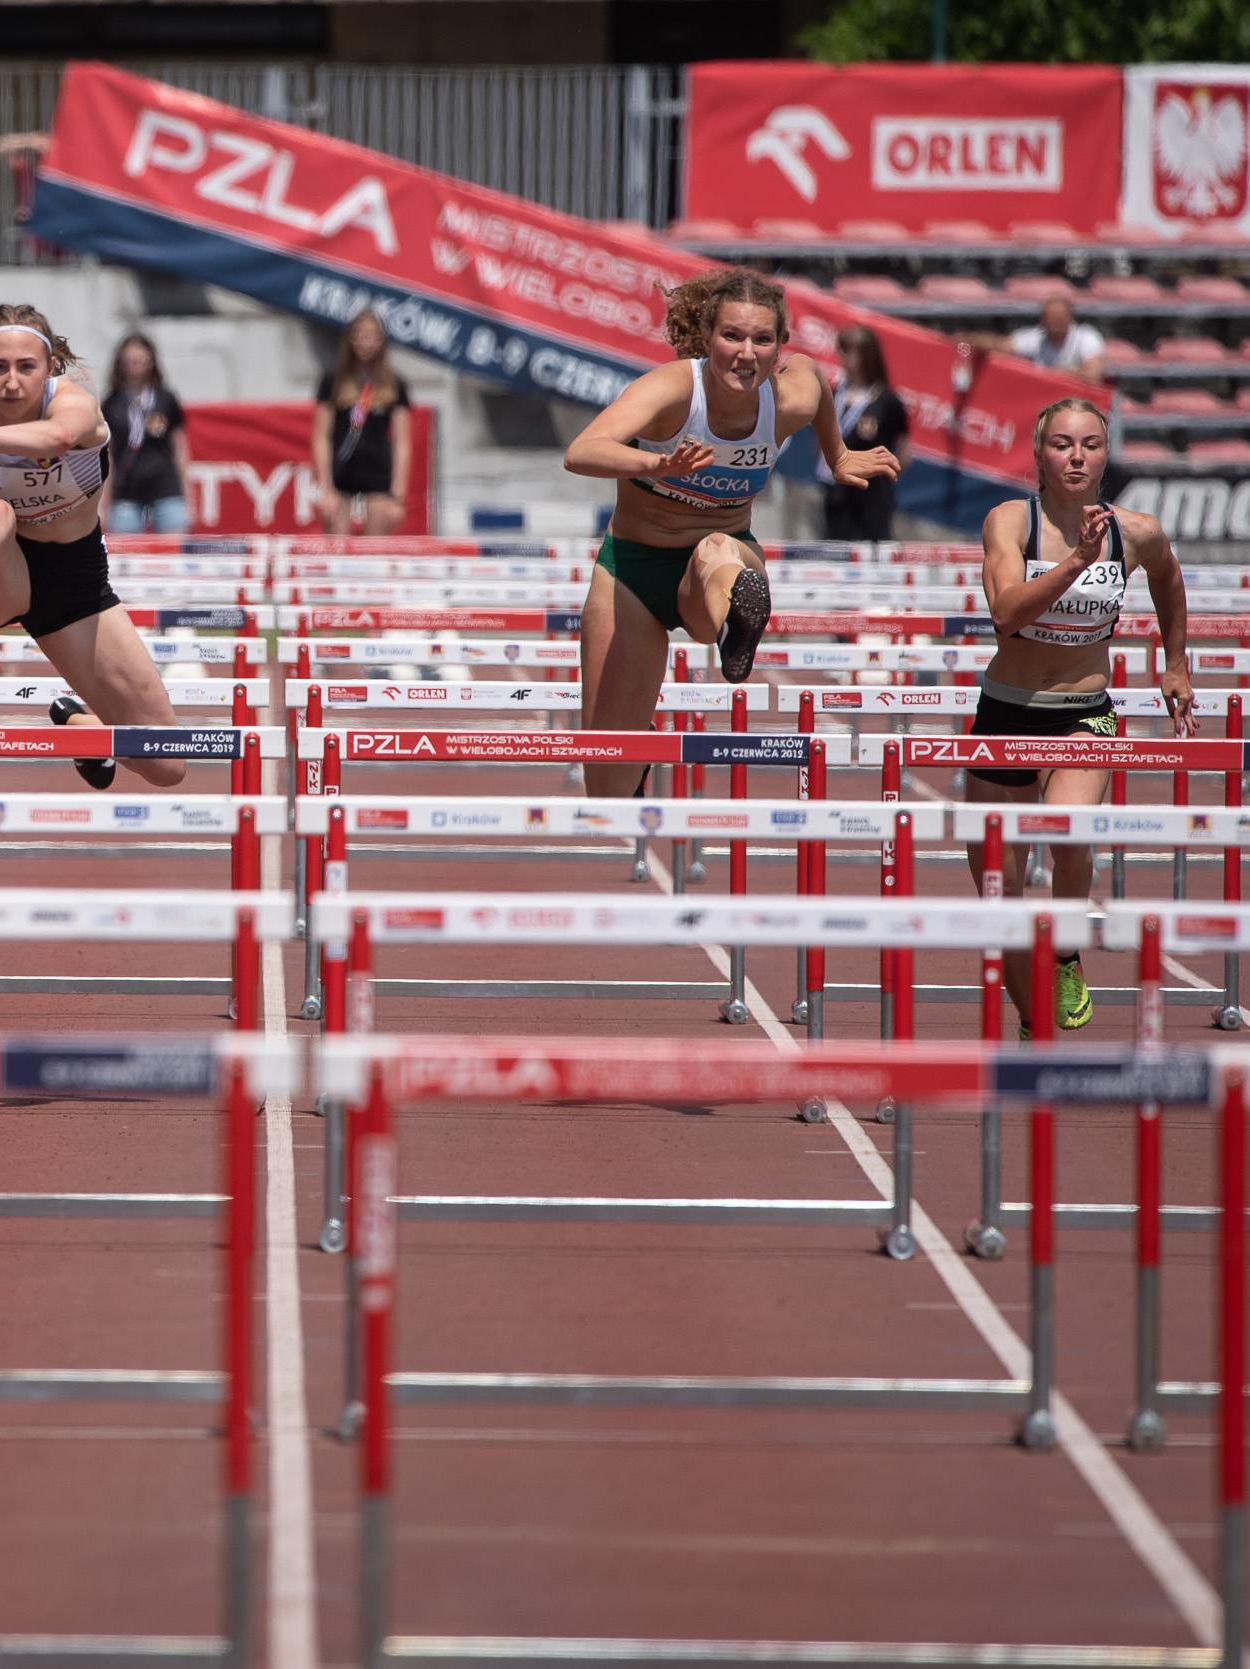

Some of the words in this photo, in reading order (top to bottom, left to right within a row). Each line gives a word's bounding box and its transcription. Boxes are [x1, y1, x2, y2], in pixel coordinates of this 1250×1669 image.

[887, 127, 1046, 178] ORLEN
[123, 109, 399, 256] PZLA
[474, 252, 667, 342] WIELOBO
[729, 447, 768, 466] 231
[24, 464, 63, 487] 577
[7, 493, 66, 510] ELSKA
[1081, 565, 1119, 586] 239
[1034, 629, 1081, 643] KRAKÓW
[15, 687, 37, 698] 4F
[408, 689, 446, 699] ORLEN
[510, 689, 532, 700] 4F
[903, 694, 940, 704] ORLEN
[1063, 695, 1093, 704] NIKE
[191, 732, 234, 743] KRAKÓW
[446, 735, 531, 744] MISTRZOSTWA
[533, 736, 573, 744] POLSKI
[761, 737, 804, 748] KRAKÓW
[143, 743, 159, 752] 8-9
[162, 743, 209, 753] CZERWCA
[211, 744, 234, 753] 2019
[353, 735, 437, 754] PZLA
[1005, 742, 1089, 751] MISTRZOSTWA
[1092, 743, 1133, 751] POLSKI
[446, 746, 457, 755] W
[459, 746, 544, 755] WIELOBOJACH
[551, 747, 622, 756] SZTAFETACH
[712, 748, 729, 757] 8-9
[731, 748, 779, 758] CZERWCA
[911, 742, 995, 761] PZLA
[1005, 753, 1016, 762] W
[1019, 753, 1104, 762] WIELOBOJACH
[1111, 754, 1183, 763] SZTAFETACH
